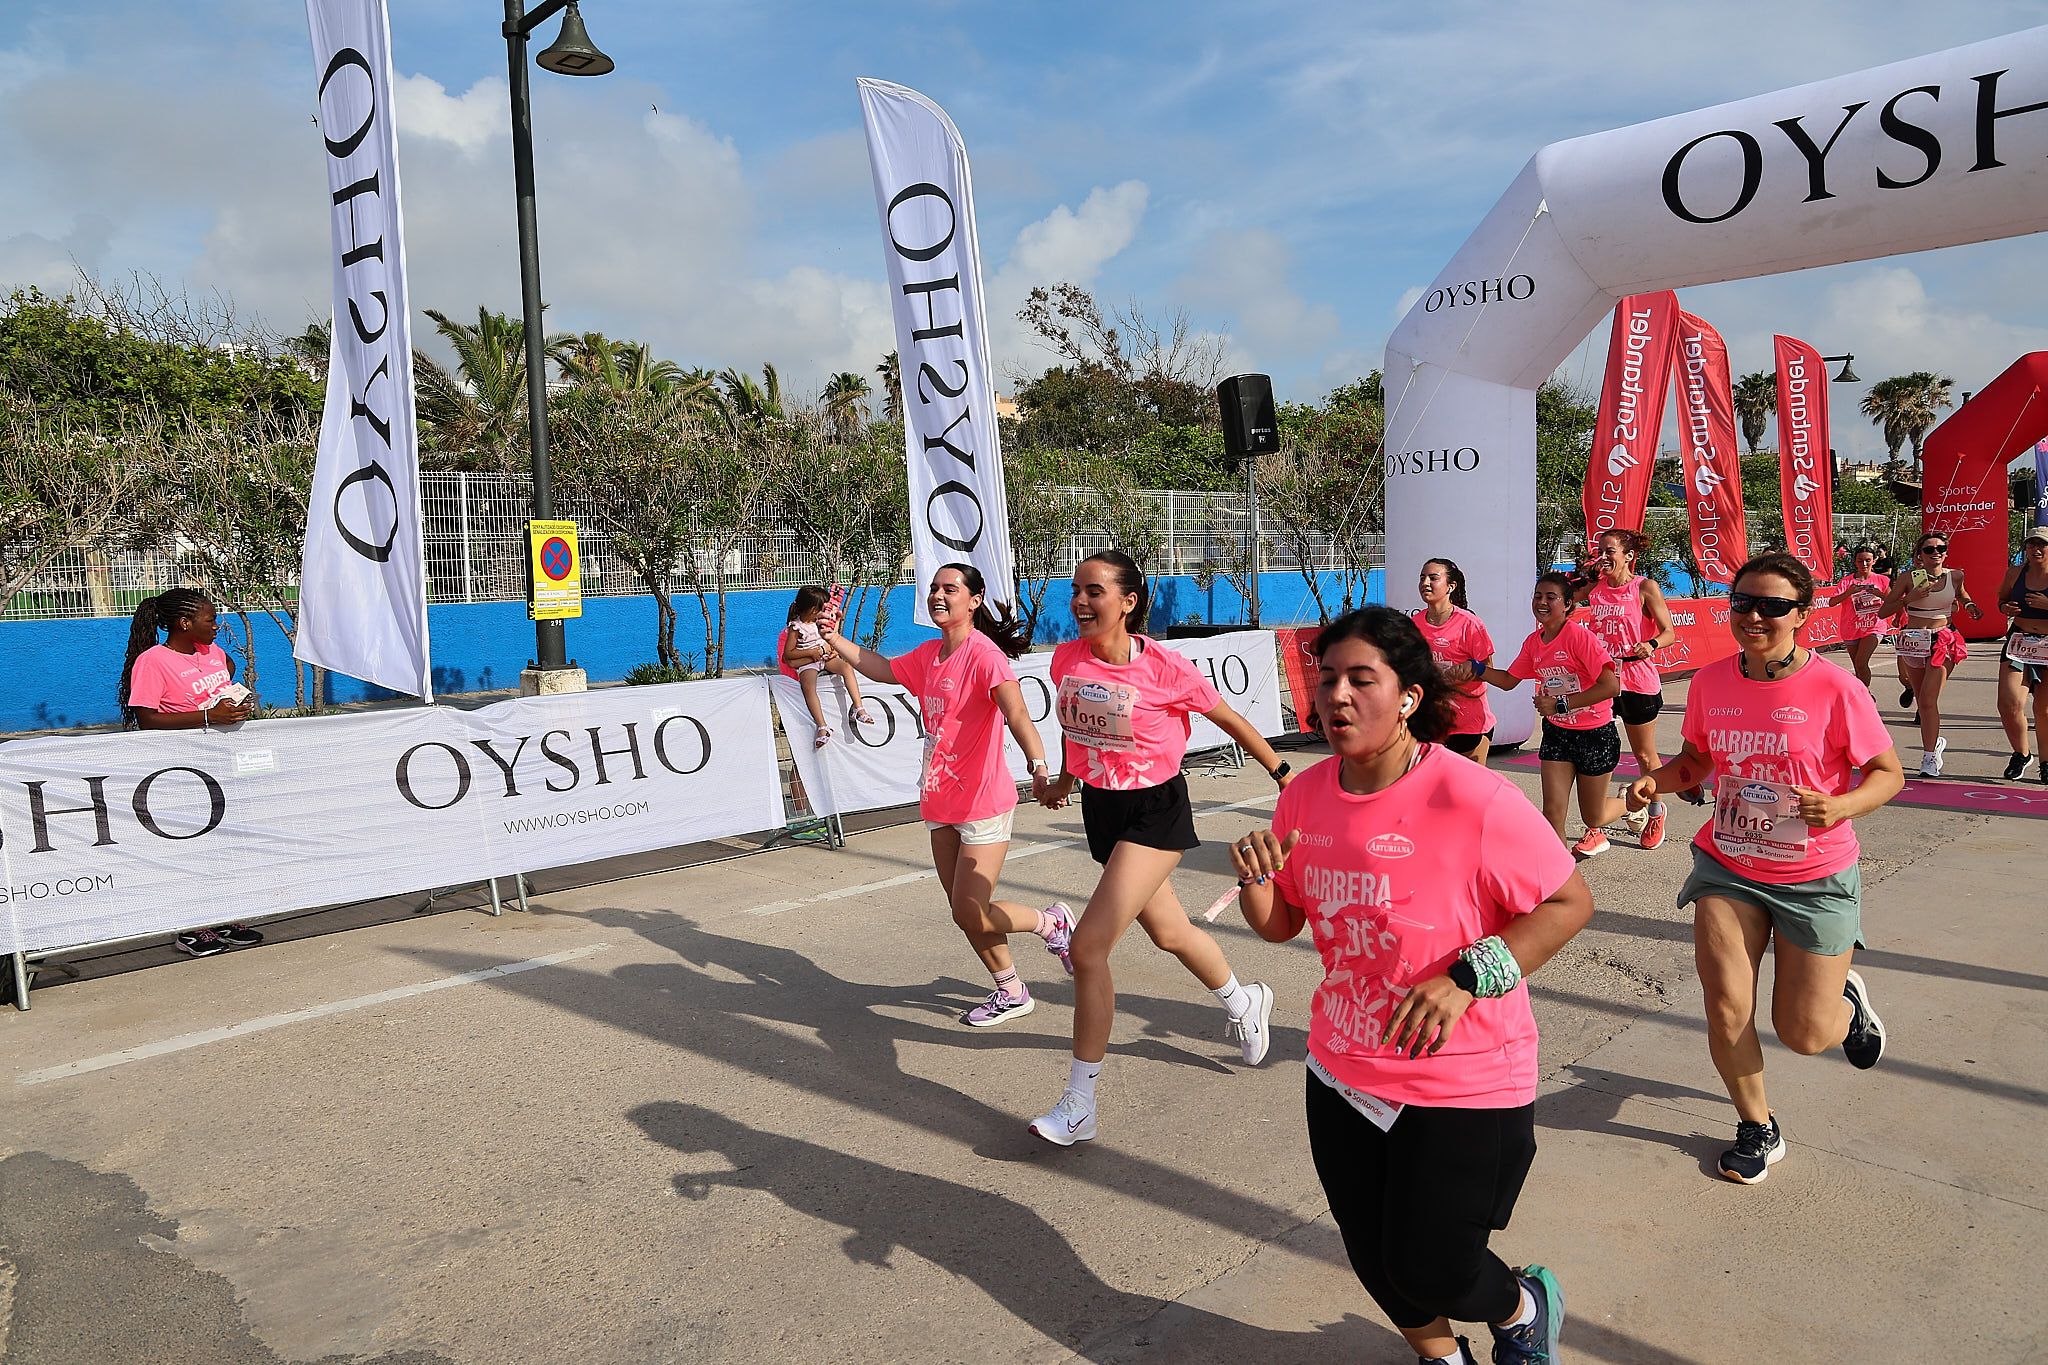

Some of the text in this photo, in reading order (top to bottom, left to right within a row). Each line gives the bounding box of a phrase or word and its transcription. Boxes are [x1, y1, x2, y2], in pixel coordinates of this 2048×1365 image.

[1424, 273, 1536, 314] OYSHO
[1386, 447, 1480, 478] OYSHO
[1938, 485, 1978, 497] Sports
[1935, 501, 1996, 513] Santander
[1080, 712, 1107, 727] 016
[1708, 707, 1743, 717] OYSHO
[1709, 729, 1788, 757] CARRERA
[396, 715, 712, 810] OYSHO
[0, 766, 226, 854] HO
[504, 801, 649, 834] WWW.OYSHO.COM
[1737, 815, 1774, 832] 016
[1299, 832, 1334, 848] OYSHO
[1369, 841, 1411, 853] ASTURIANA
[1720, 843, 1746, 853] OYSHO
[1764, 850, 1795, 860] Santander
[1304, 864, 1392, 909] CARRERA
[1320, 988, 1381, 1050] MUJER
[1351, 1093, 1384, 1117] Santander
